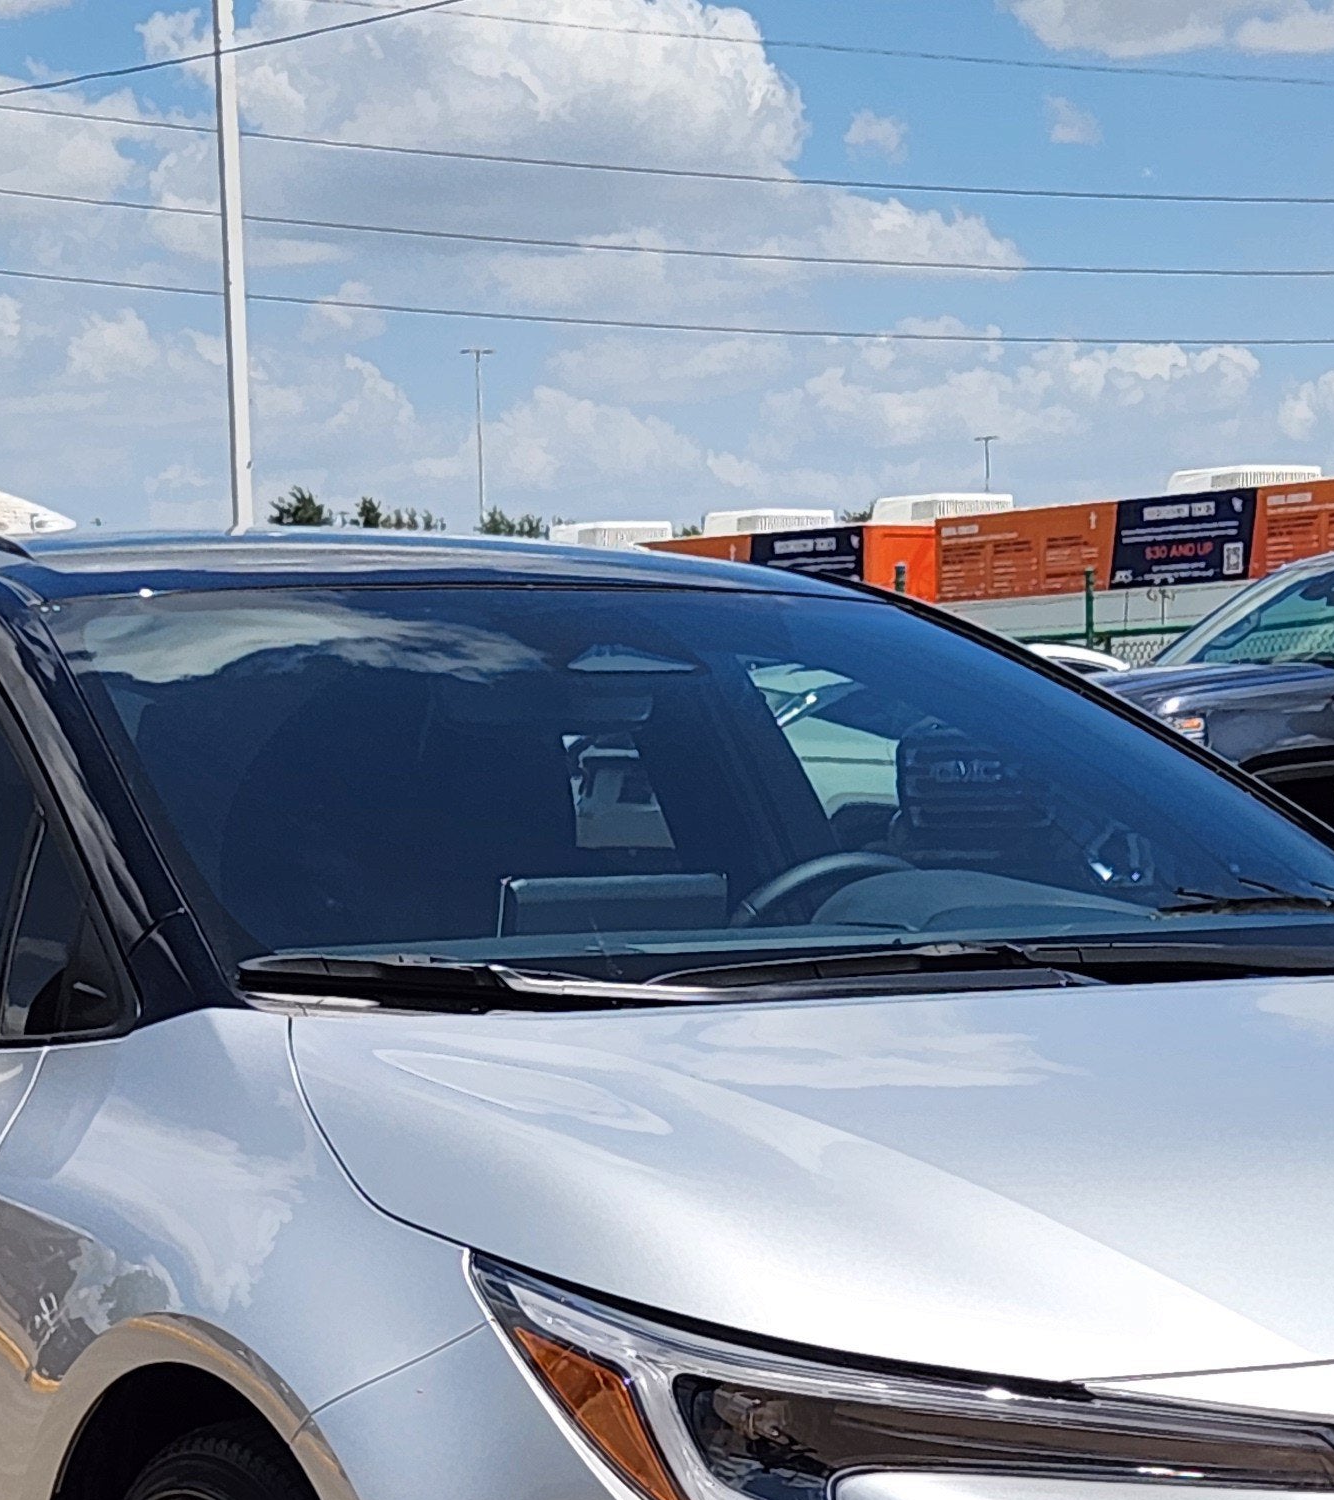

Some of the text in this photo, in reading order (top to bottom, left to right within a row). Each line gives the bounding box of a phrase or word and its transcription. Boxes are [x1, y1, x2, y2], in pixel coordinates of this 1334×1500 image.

[1145, 541, 1214, 560] $30 AND UP
